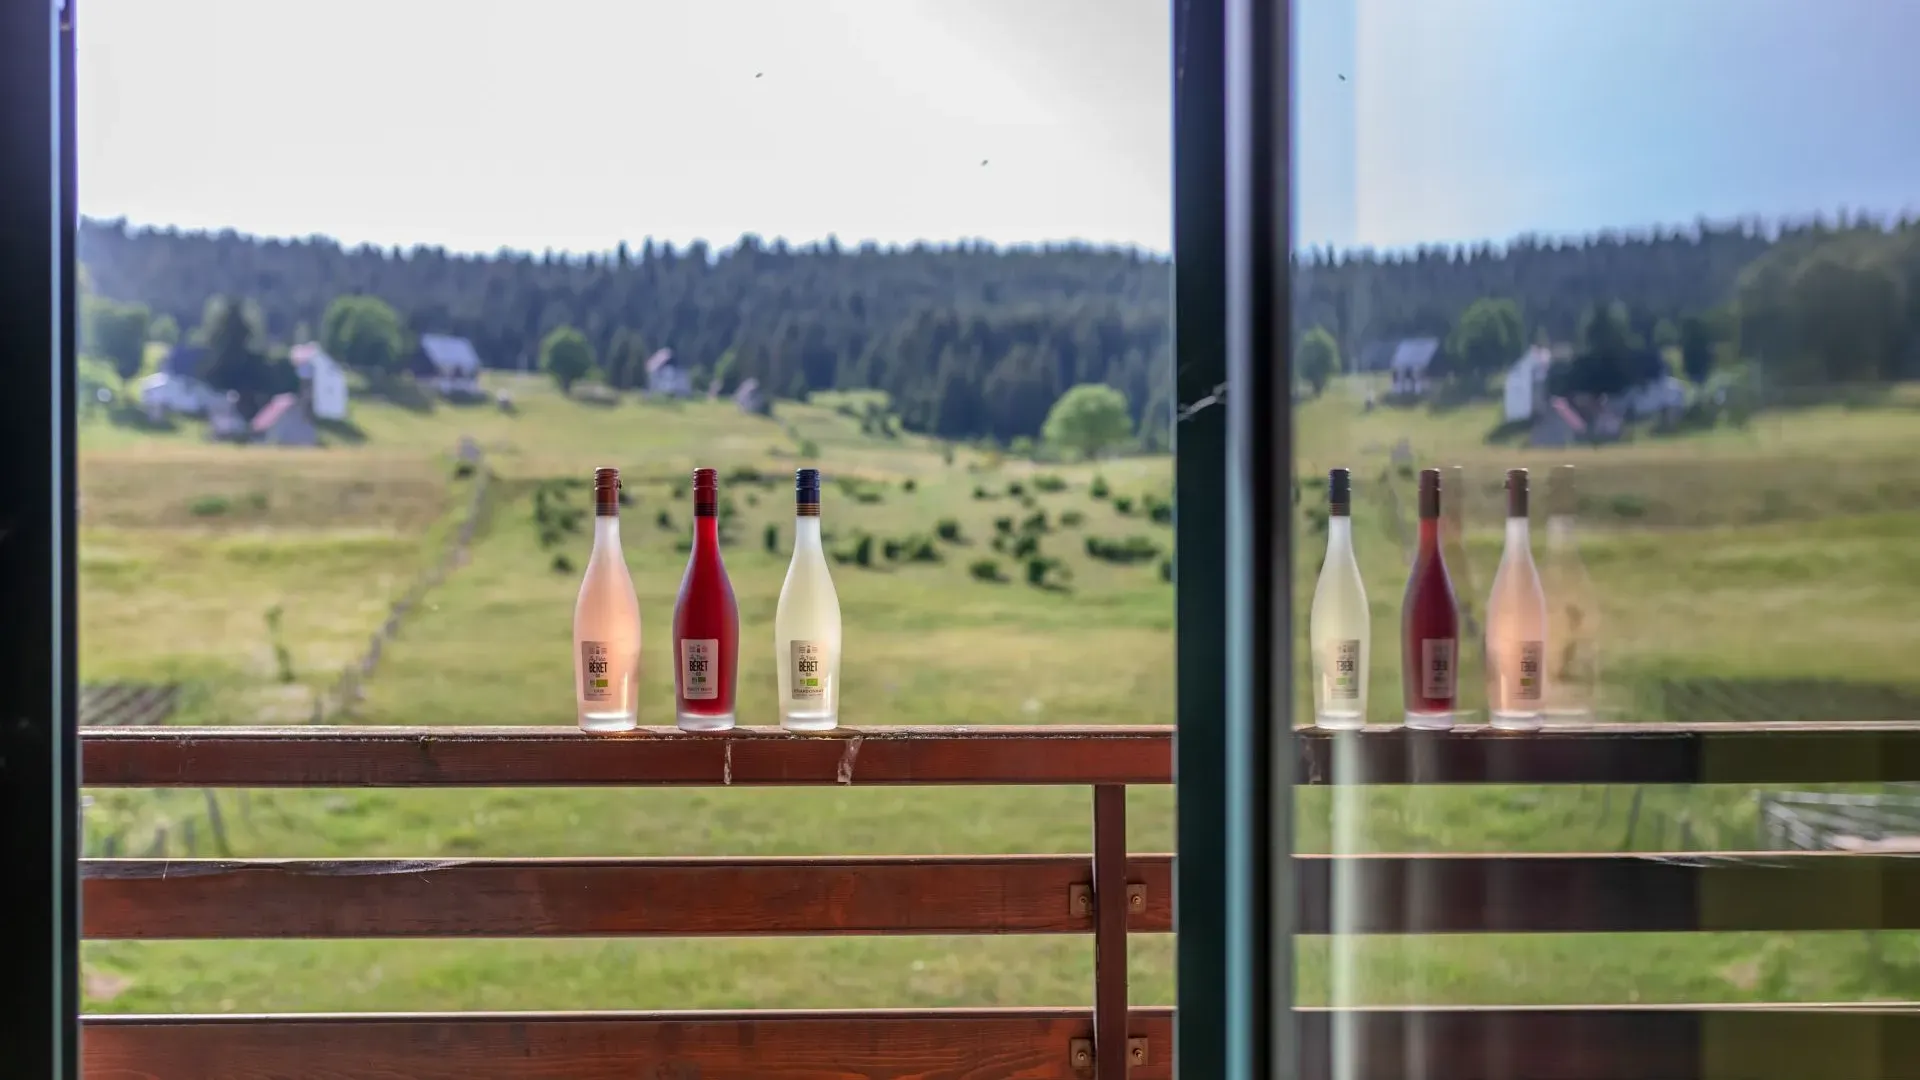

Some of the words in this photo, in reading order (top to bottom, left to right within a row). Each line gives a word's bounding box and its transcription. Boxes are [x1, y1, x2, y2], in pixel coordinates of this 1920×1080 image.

[589, 660, 608, 673] BÉRET
[689, 658, 708, 672] BÉRET
[799, 659, 818, 672] BÉRET
